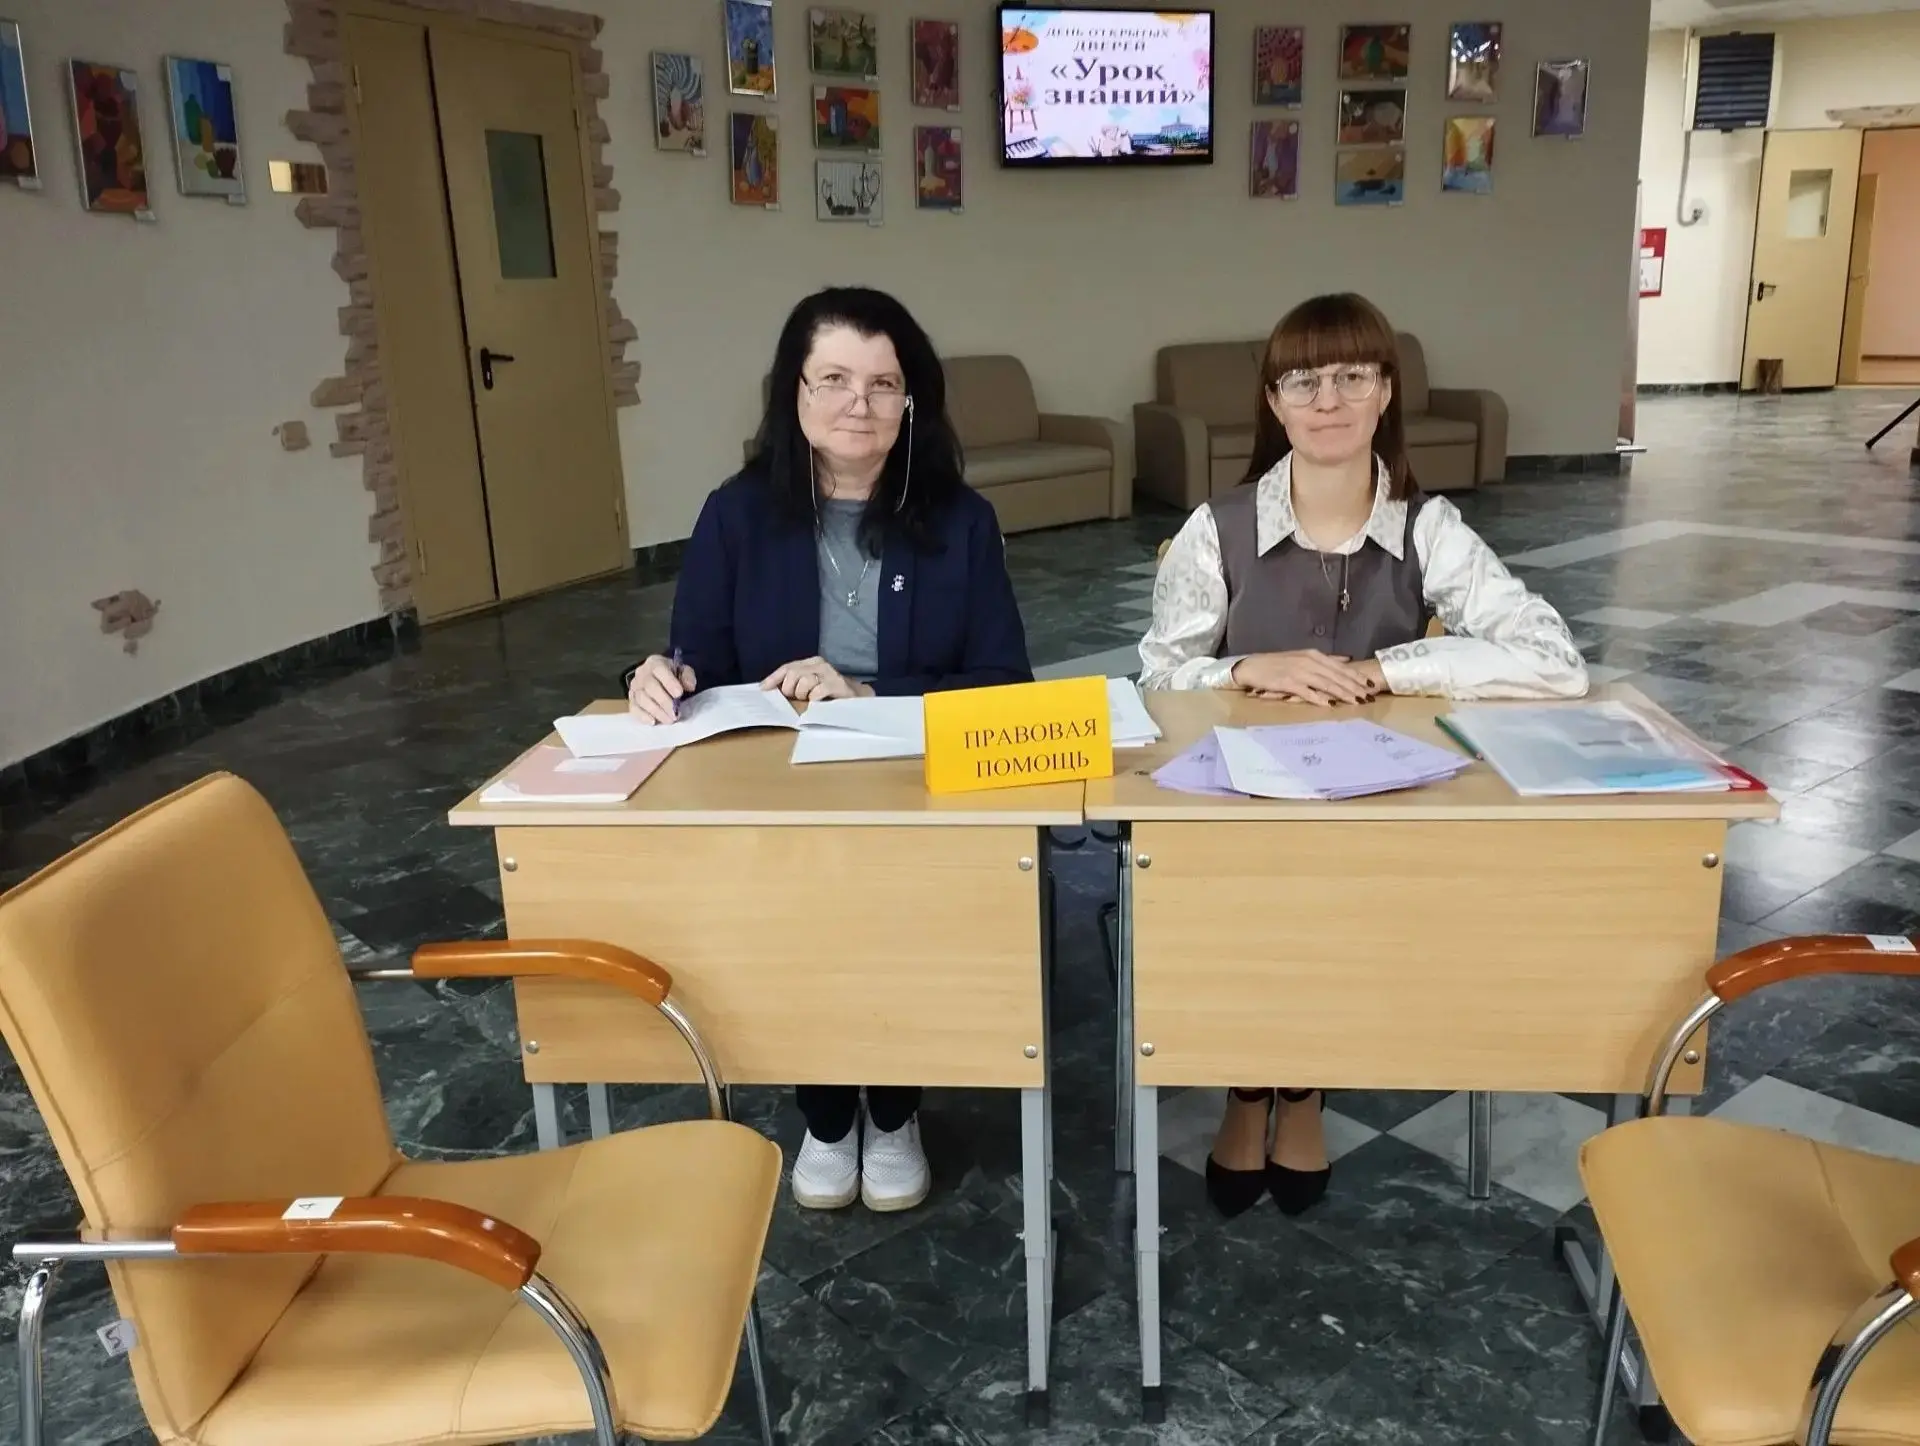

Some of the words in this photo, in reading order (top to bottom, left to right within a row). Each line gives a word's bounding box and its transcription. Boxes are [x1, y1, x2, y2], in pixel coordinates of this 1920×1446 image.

[1045, 26, 1084, 38] ДЕНЬ
[1087, 26, 1170, 39] ОТКРЫТЫХ
[1073, 39, 1147, 52] ДВЕРЕЙ
[1050, 56, 1165, 86] «Урок
[1044, 83, 1196, 105] знаний»
[964, 718, 1097, 749] ПРАВОВАЯ
[976, 750, 1090, 779] ПОМОЩЬ
